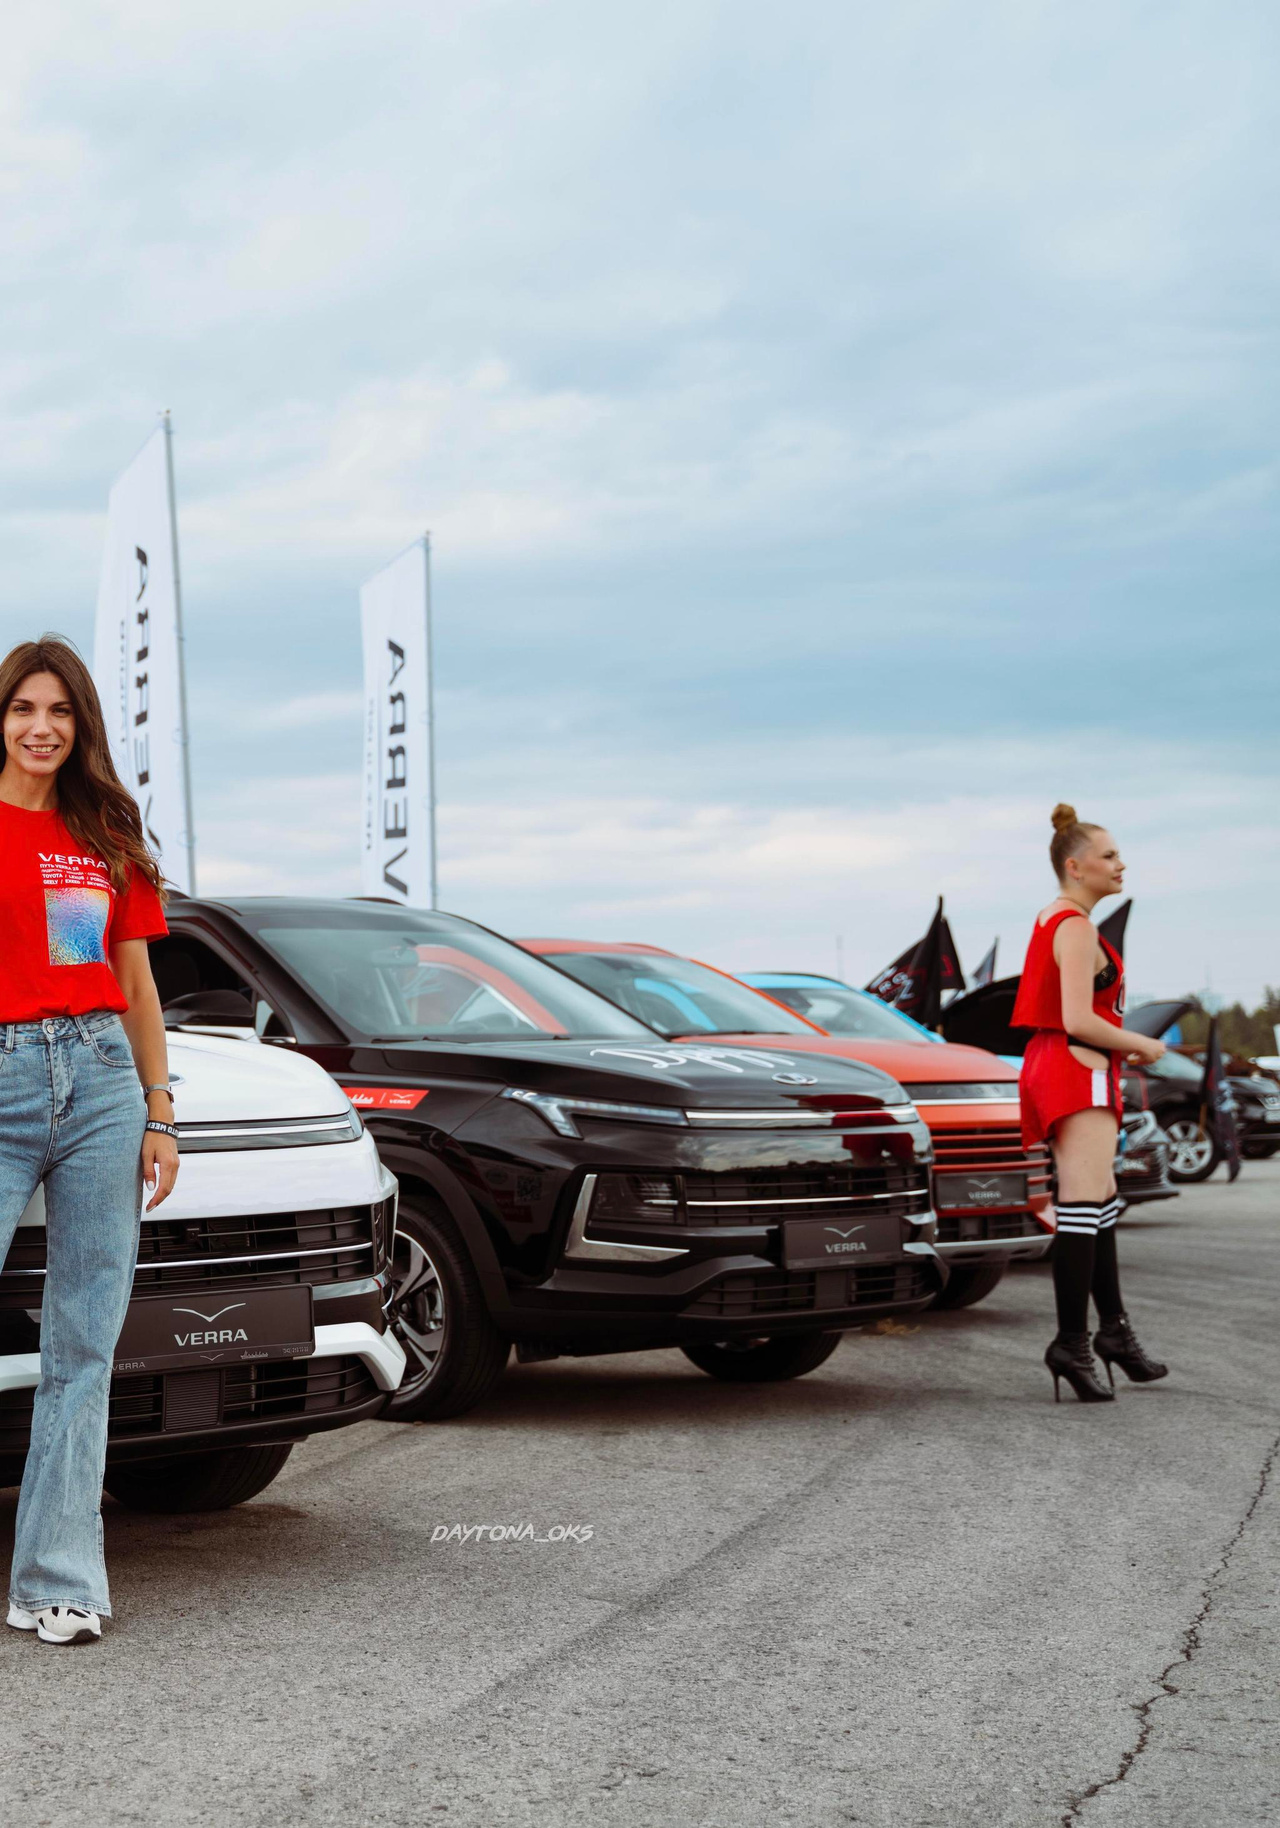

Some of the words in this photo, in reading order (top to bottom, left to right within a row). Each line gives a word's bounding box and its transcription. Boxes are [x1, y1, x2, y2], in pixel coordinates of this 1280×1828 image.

[38, 852, 108, 871] VERRA
[825, 1242, 867, 1254] VERRA
[174, 1328, 249, 1347] VERRA
